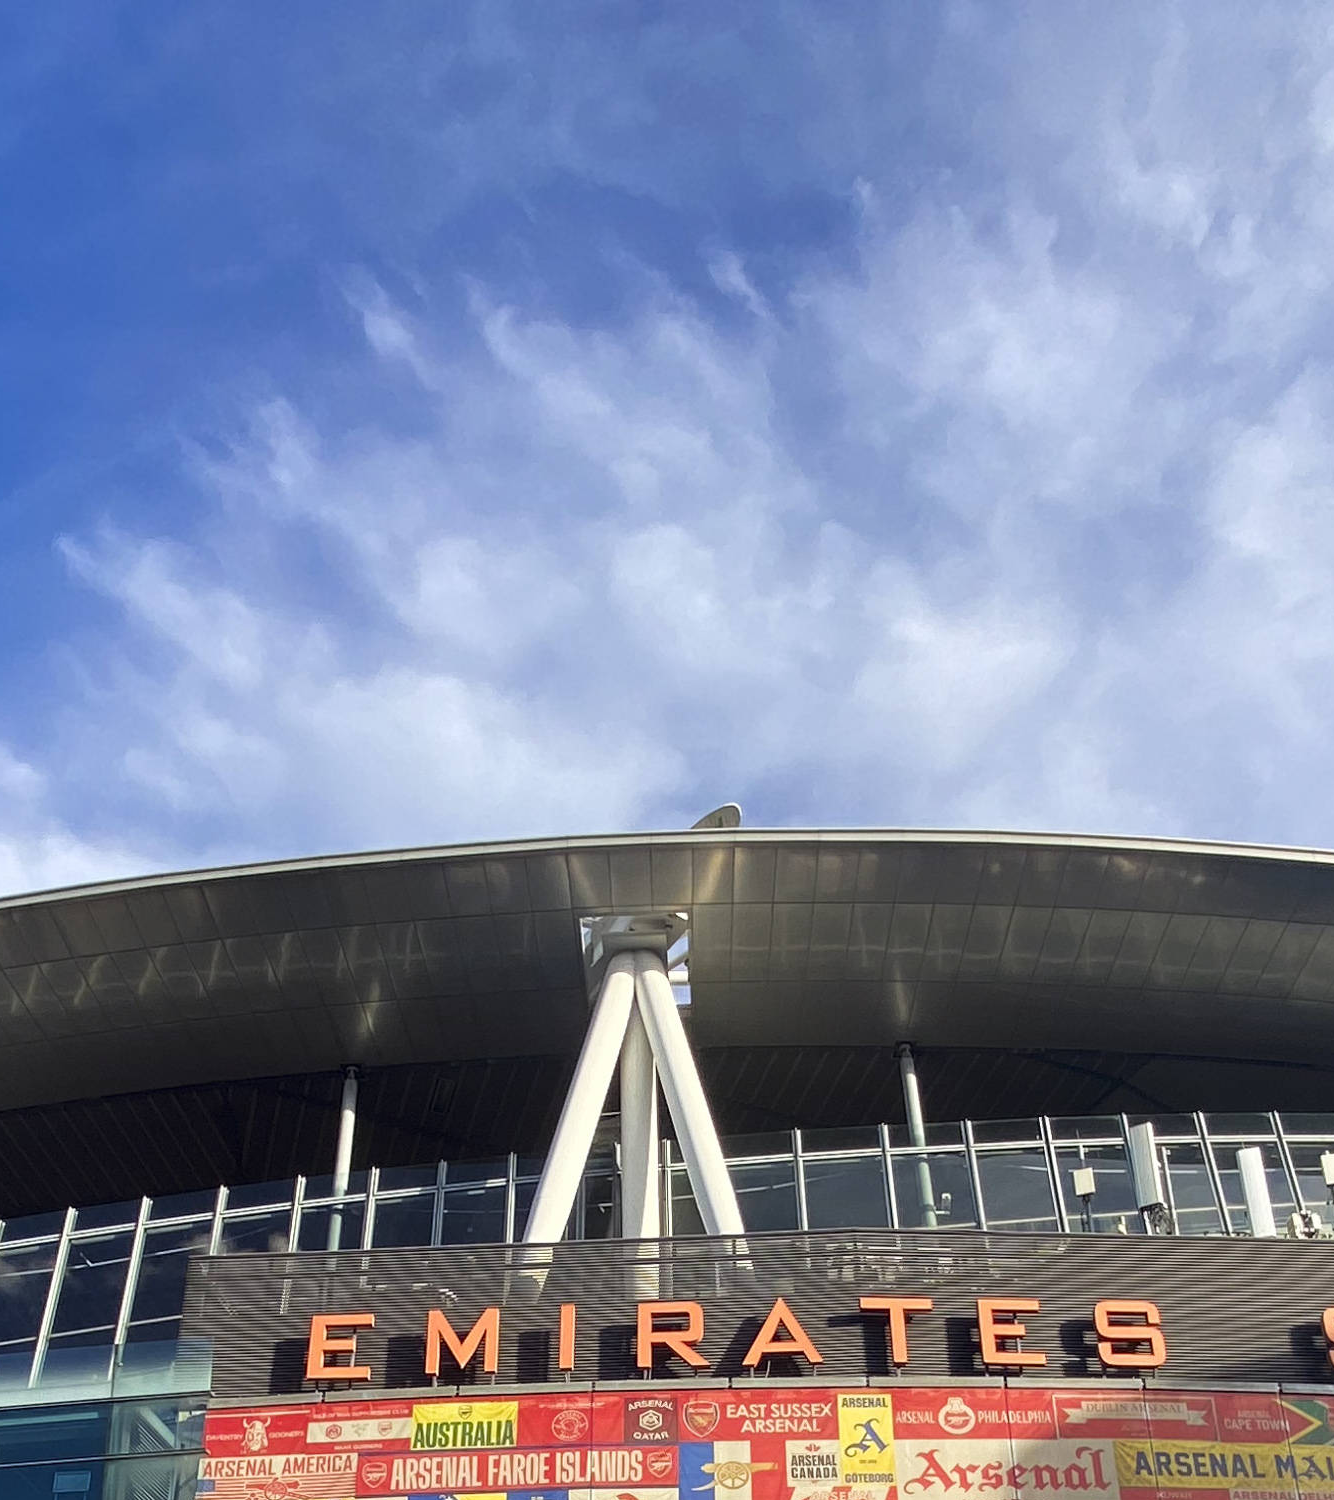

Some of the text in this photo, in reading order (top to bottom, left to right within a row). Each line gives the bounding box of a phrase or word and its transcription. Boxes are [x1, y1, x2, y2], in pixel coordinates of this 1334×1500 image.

[306, 1296, 1167, 1380] EMIRATES
[627, 1399, 674, 1411] ARSENAL
[841, 1397, 888, 1408] ARSENAL
[726, 1402, 833, 1419] EAST SUSSEX
[896, 1410, 1051, 1425] ARSENAL PHILADELPHIA
[740, 1418, 821, 1434] ARSENAL
[1224, 1419, 1289, 1431] CAPE TOWN
[413, 1420, 515, 1449] AUSTRALIA
[632, 1430, 670, 1441] QATAR
[202, 1454, 354, 1478] ARSENAL AMERICA
[790, 1454, 837, 1467] ARSENAL
[1134, 1451, 1266, 1478] ARSENAL
[390, 1449, 643, 1491] ARSENAL FAROE ISLANDS
[790, 1466, 838, 1480] CANADA
[845, 1471, 894, 1484] GÖTEBORG
[903, 1446, 1112, 1495] Arsenal
[1232, 1490, 1295, 1500] ARSENAL
